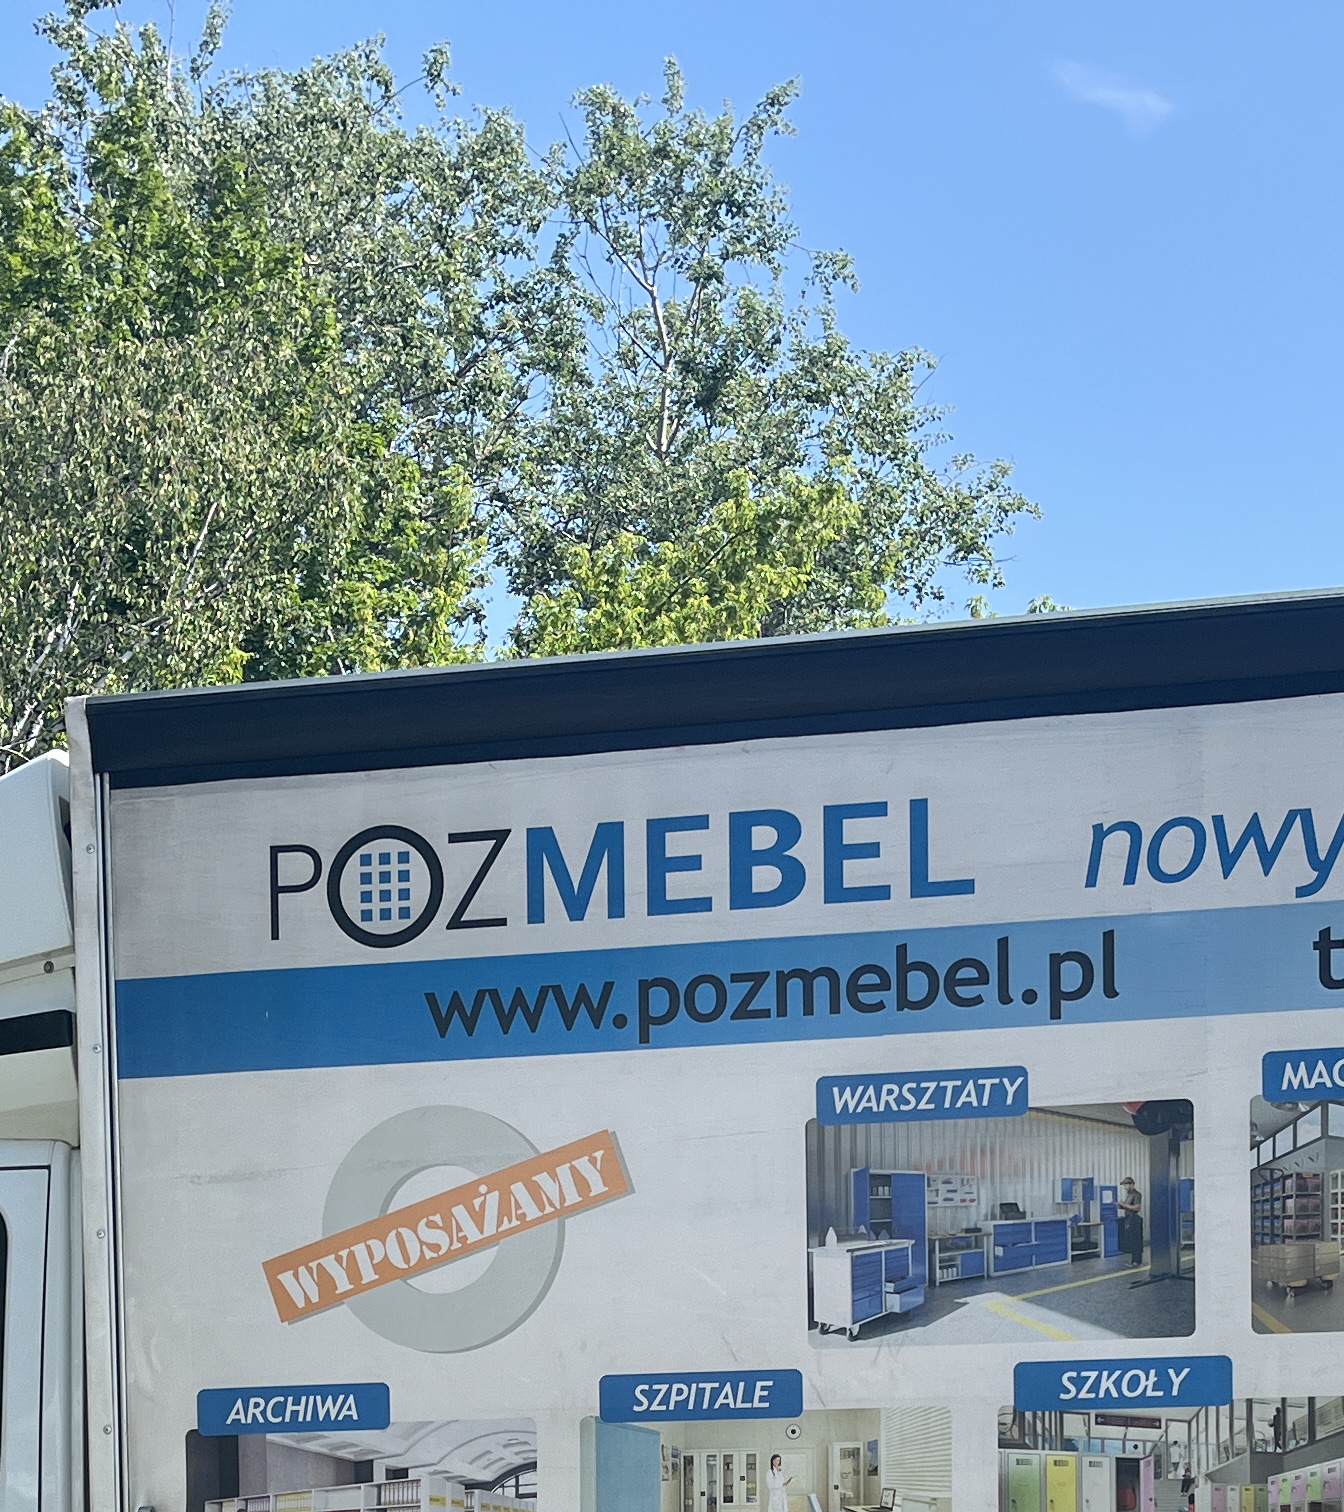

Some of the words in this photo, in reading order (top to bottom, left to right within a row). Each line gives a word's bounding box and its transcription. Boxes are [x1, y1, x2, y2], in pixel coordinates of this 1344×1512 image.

[269, 798, 976, 949] POZMEBEL
[423, 928, 1120, 1045] www.pozmebel.pl
[831, 1076, 1025, 1115] WARSZTATY
[276, 1149, 609, 1310] WYPOSAŻAMY
[632, 1380, 774, 1412] SZPITALE
[1059, 1367, 1191, 1400] SZKOŁY
[225, 1393, 359, 1425] ARCHIWA
